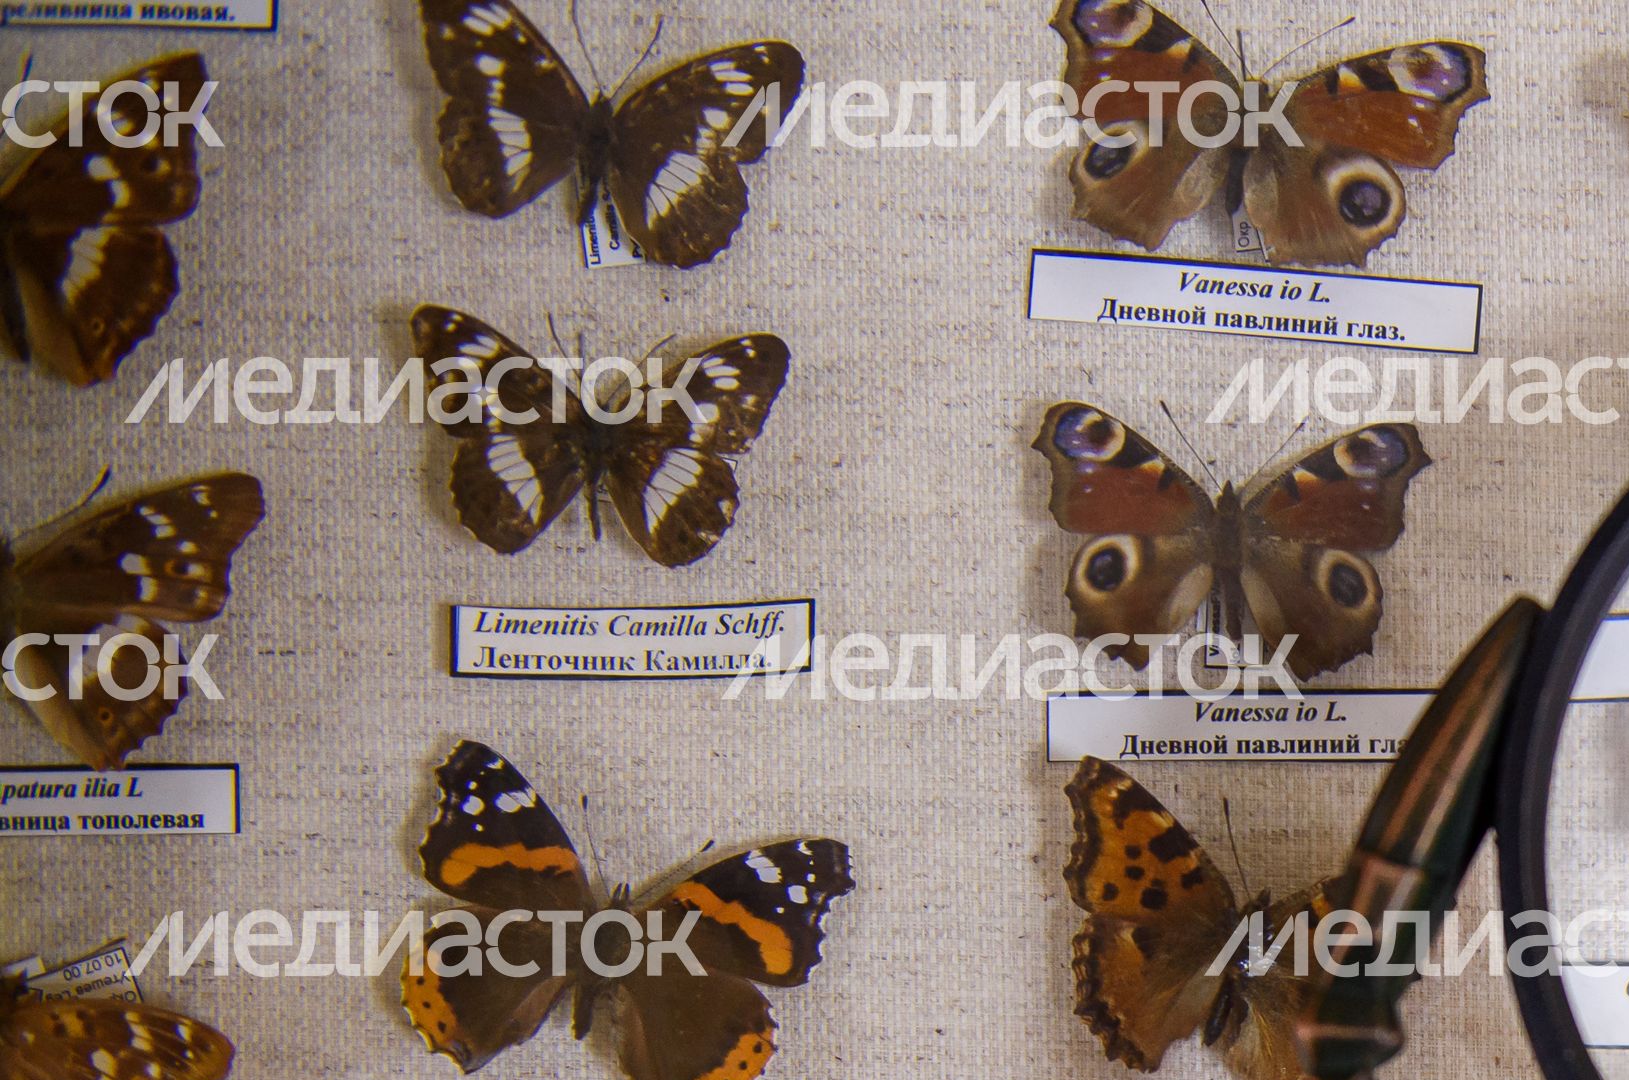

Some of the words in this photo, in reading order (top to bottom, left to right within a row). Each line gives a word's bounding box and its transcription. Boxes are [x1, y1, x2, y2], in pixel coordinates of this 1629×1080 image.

[1177, 271, 1273, 299] Vanessa
[1279, 278, 1303, 302] io
[1309, 282, 1330, 303] L.
[1097, 298, 1206, 326] Дневной
[1213, 309, 1339, 336] павлиний
[1346, 317, 1405, 342] глаз.
[473, 608, 598, 638] Limenitis
[608, 612, 707, 638] Camilla
[473, 643, 635, 673] Ленточник
[1194, 701, 1290, 724] Vanessa
[1298, 701, 1318, 723] io
[1325, 701, 1347, 723] L.
[1120, 731, 1228, 759] Дневной
[1235, 731, 1361, 756] павлиний
[83, 777, 120, 799] ilia
[125, 777, 143, 798] L
[78, 808, 205, 831] тополевая
